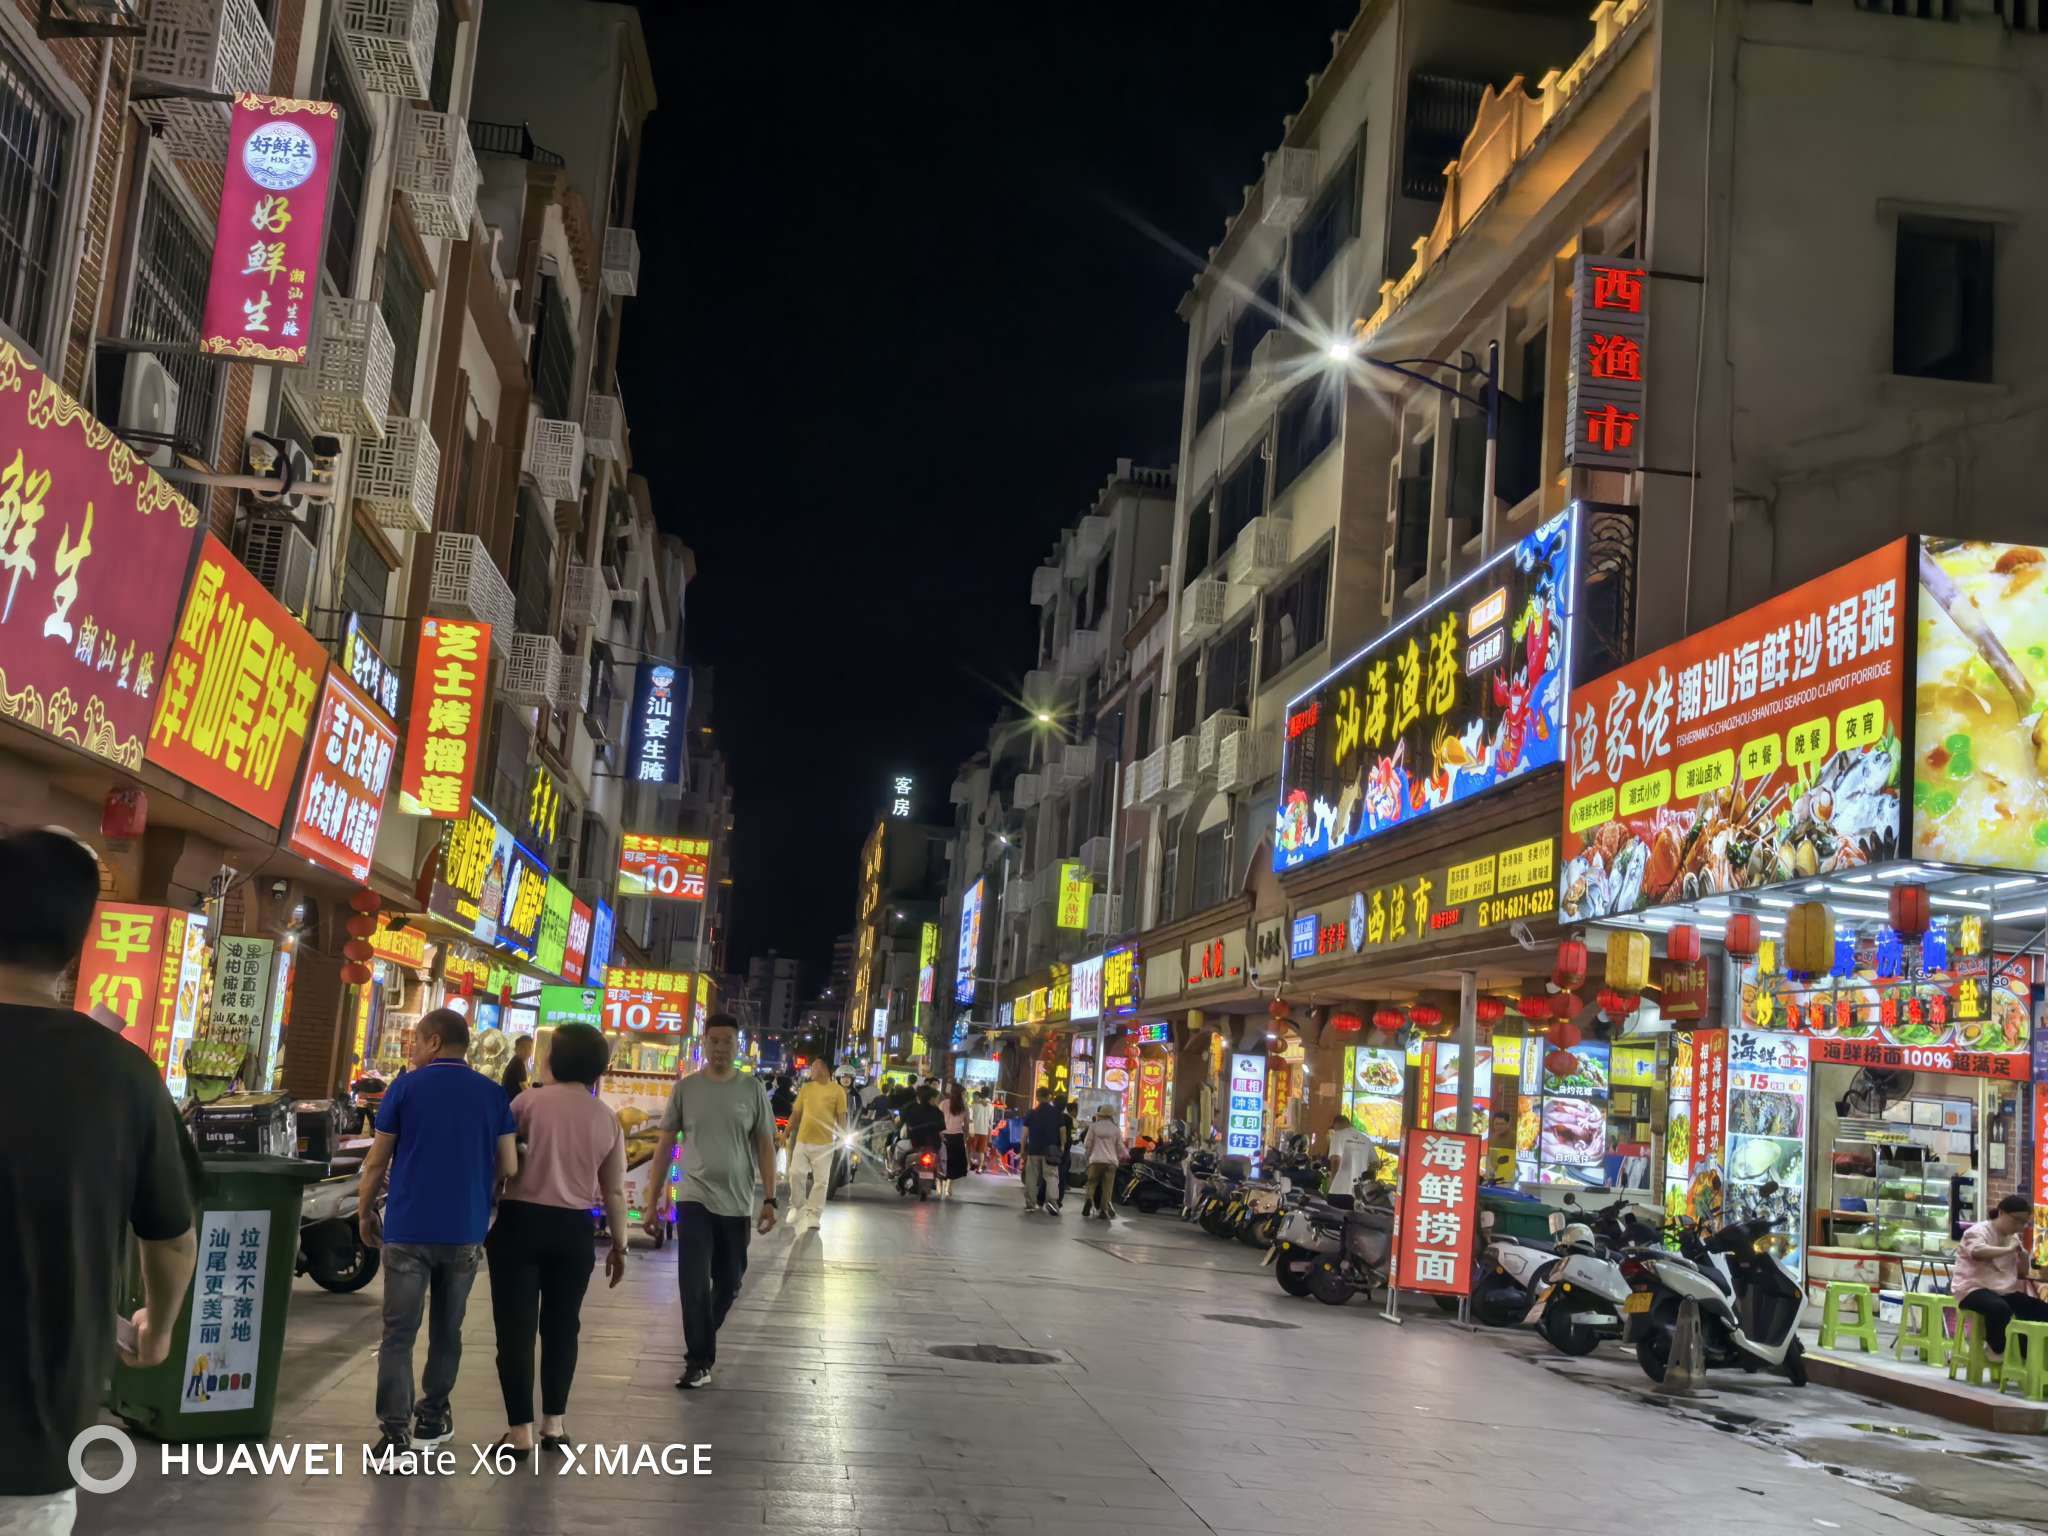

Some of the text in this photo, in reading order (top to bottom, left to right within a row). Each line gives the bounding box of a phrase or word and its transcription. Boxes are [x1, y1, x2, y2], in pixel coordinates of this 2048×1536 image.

[250, 135, 312, 158] 好鲜生
[271, 156, 290, 164] HXS
[241, 193, 292, 332] 好鲜生
[1584, 266, 1647, 453] 西渔市
[1676, 578, 1897, 726] 潮汕海鲜沙锅粥
[1784, 687, 1818, 712] SEAFOOD
[1817, 675, 1852, 700] CLAYPOT
[1851, 659, 1893, 690] PORRIDGE
[418, 624, 481, 813] 芝士烤榴莲
[1570, 664, 1675, 791] 渔家佬
[1845, 711, 1875, 740] 夜宵
[1748, 745, 1773, 770] 中餐
[1794, 731, 1822, 756] 晚餐
[1686, 759, 1723, 790] 潮汕卤水
[892, 776, 913, 817] 客房
[1368, 877, 1433, 945] 西渔市
[1731, 1032, 1777, 1065] 海鲜
[1749, 1073, 1769, 1090] 15
[1232, 1135, 1258, 1148] 打字
[1414, 1135, 1467, 1285] 海鲜捞面
[200, 1227, 261, 1344] 汕尾更美丽 垃圾不落地
